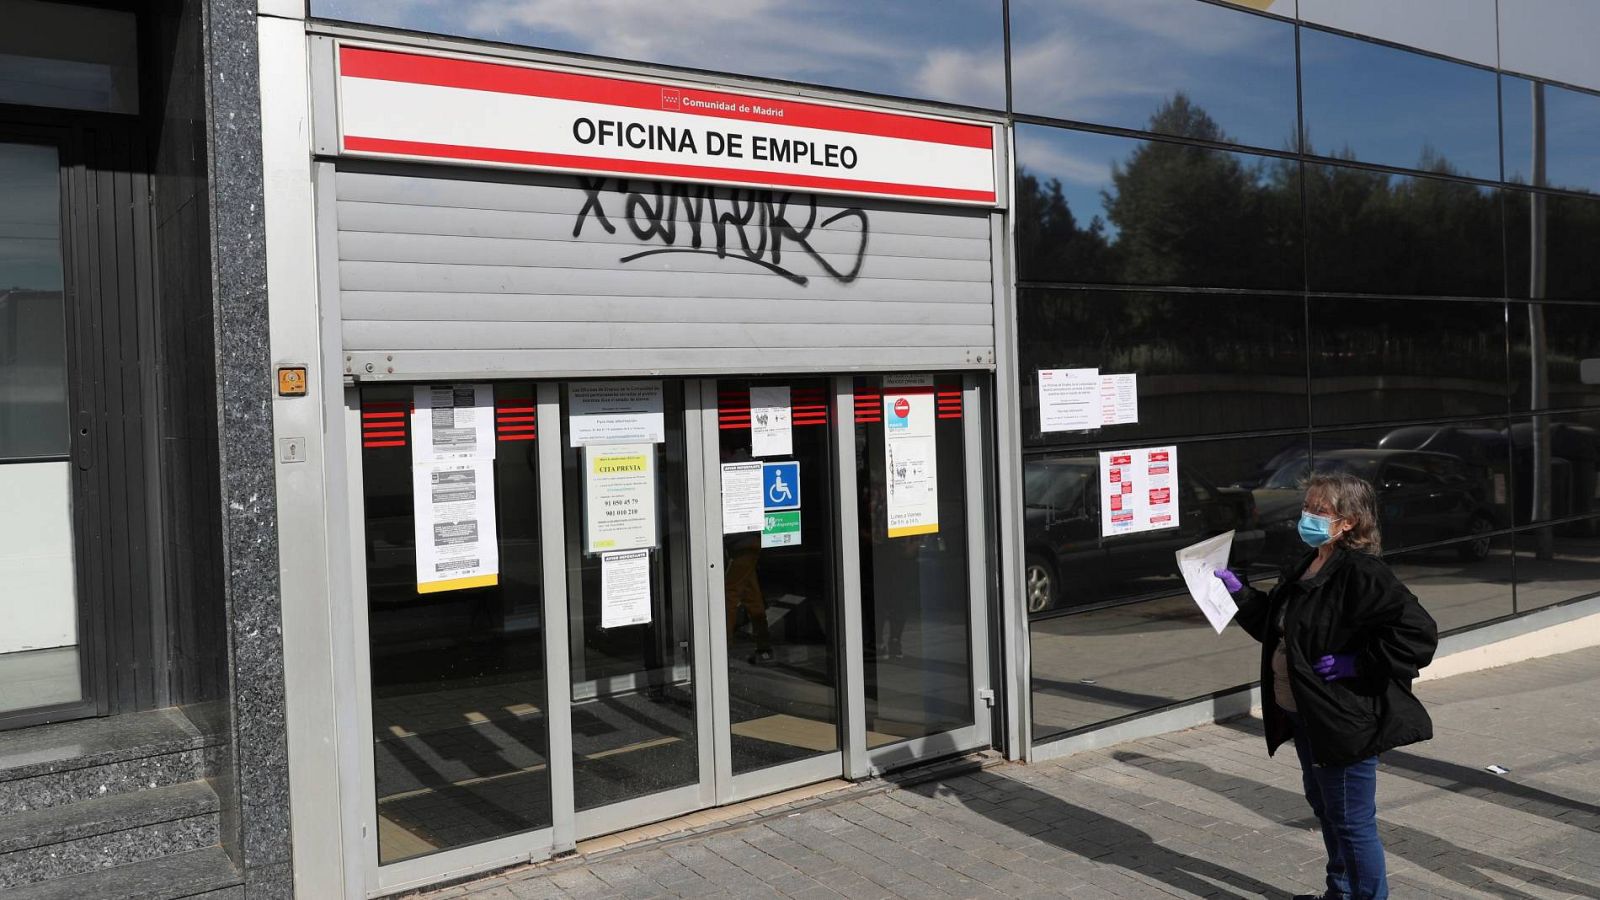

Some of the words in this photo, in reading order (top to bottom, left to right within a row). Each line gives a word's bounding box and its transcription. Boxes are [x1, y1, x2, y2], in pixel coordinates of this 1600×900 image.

[682, 96, 736, 112] Comunidad
[738, 104, 750, 113] de
[752, 105, 784, 117] Madrid
[572, 117, 698, 154] OFICINA
[706, 131, 743, 158] DE
[752, 136, 858, 169] EMPLEO
